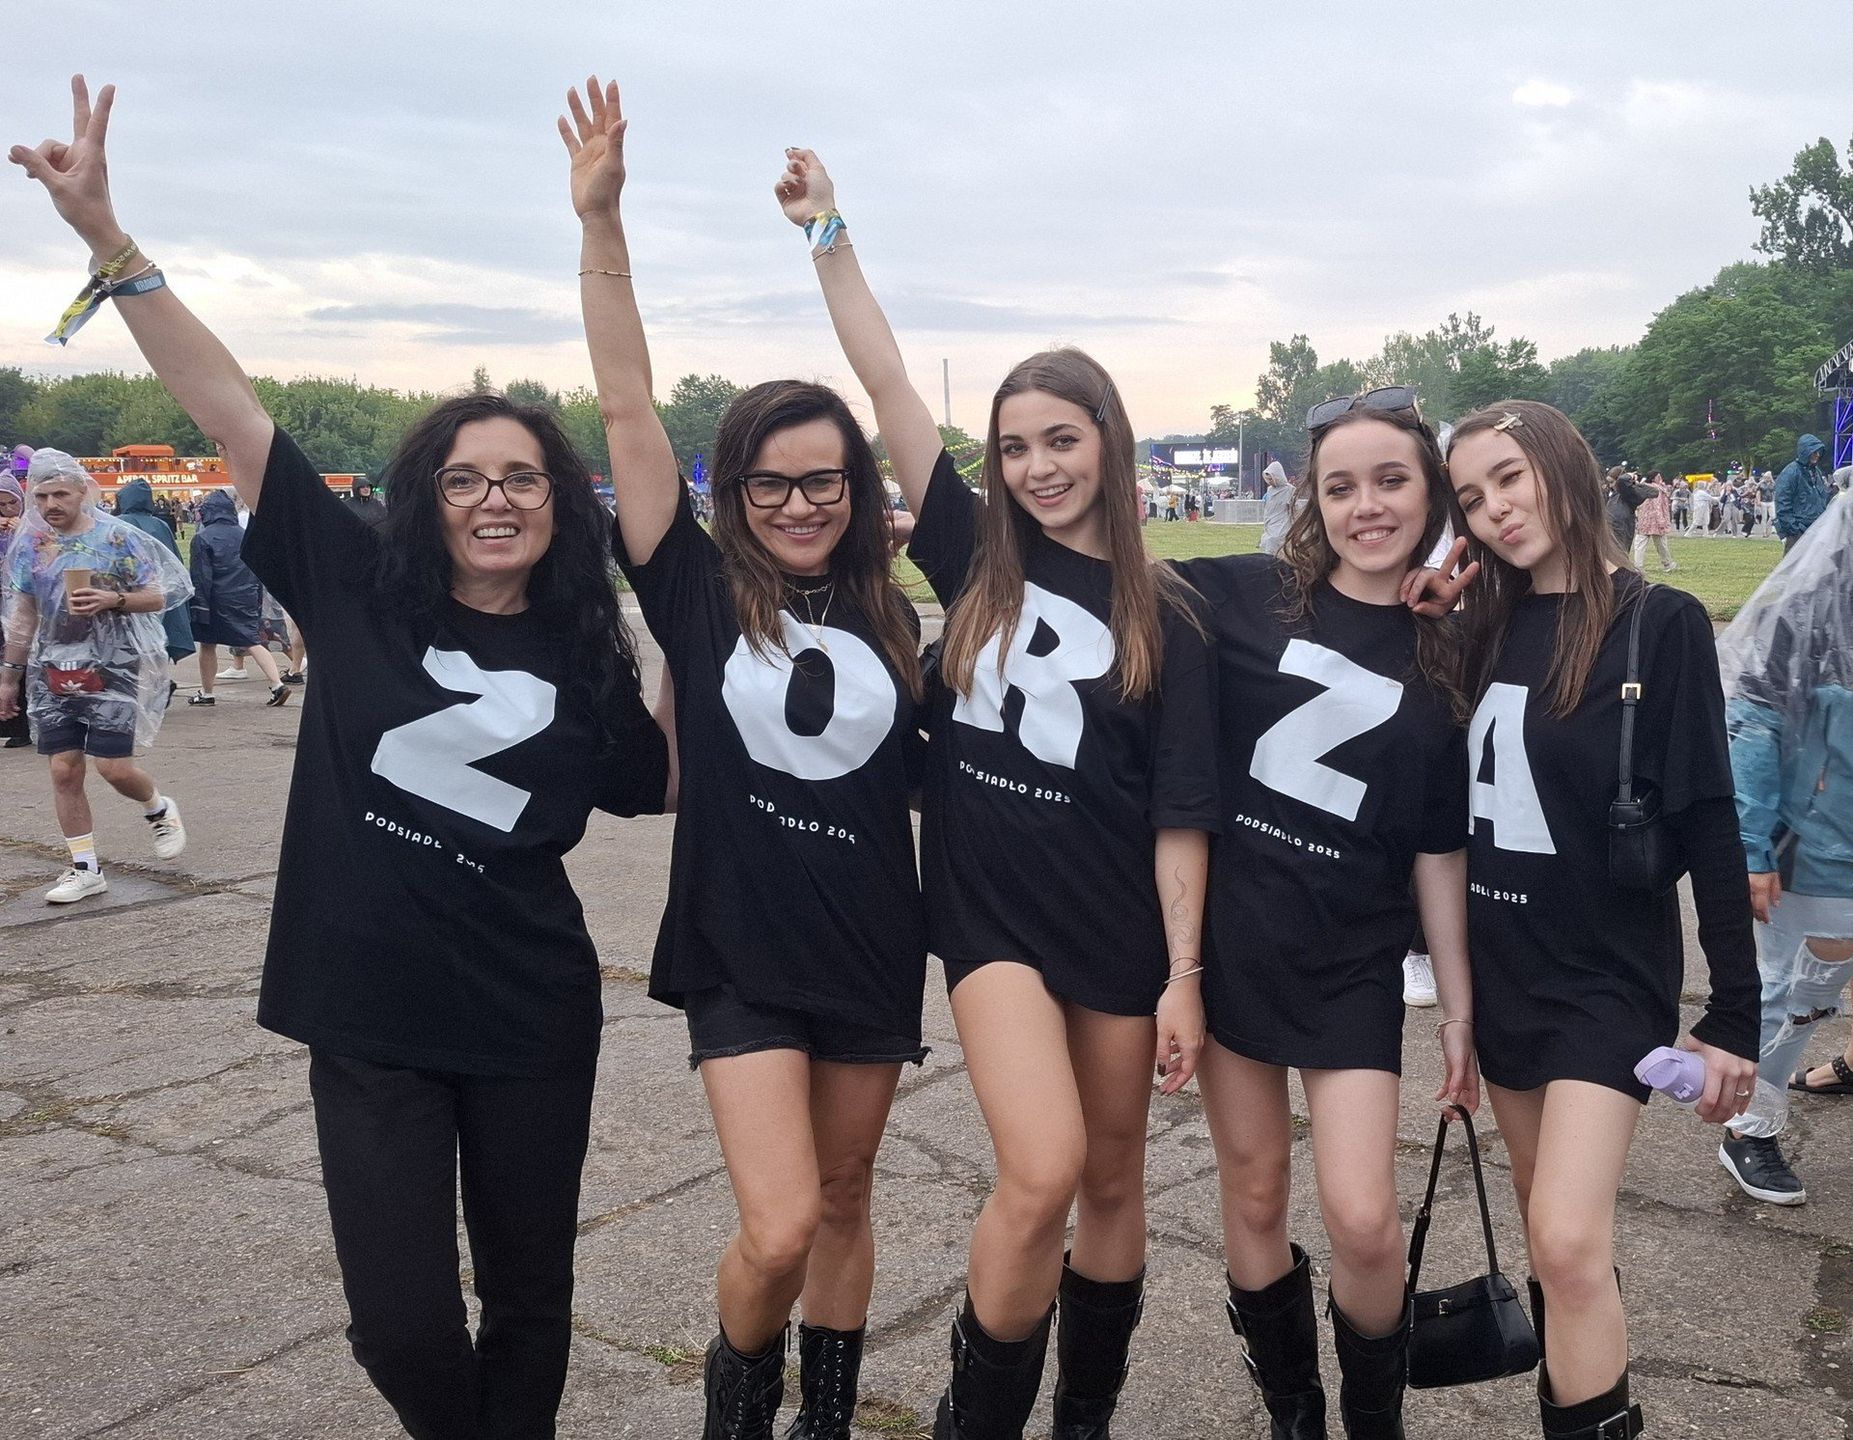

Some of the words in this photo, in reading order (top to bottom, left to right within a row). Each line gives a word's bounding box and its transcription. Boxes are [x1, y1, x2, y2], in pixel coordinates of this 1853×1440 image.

[152, 474, 180, 484] SPRITZ
[181, 474, 198, 483] BAR
[371, 646, 557, 833] Z
[721, 609, 897, 781] O
[952, 581, 1116, 770] R
[1249, 638, 1404, 822] Z
[1307, 843, 1340, 859] 2025
[1468, 682, 1557, 854] A
[1493, 890, 1528, 904] 2025
